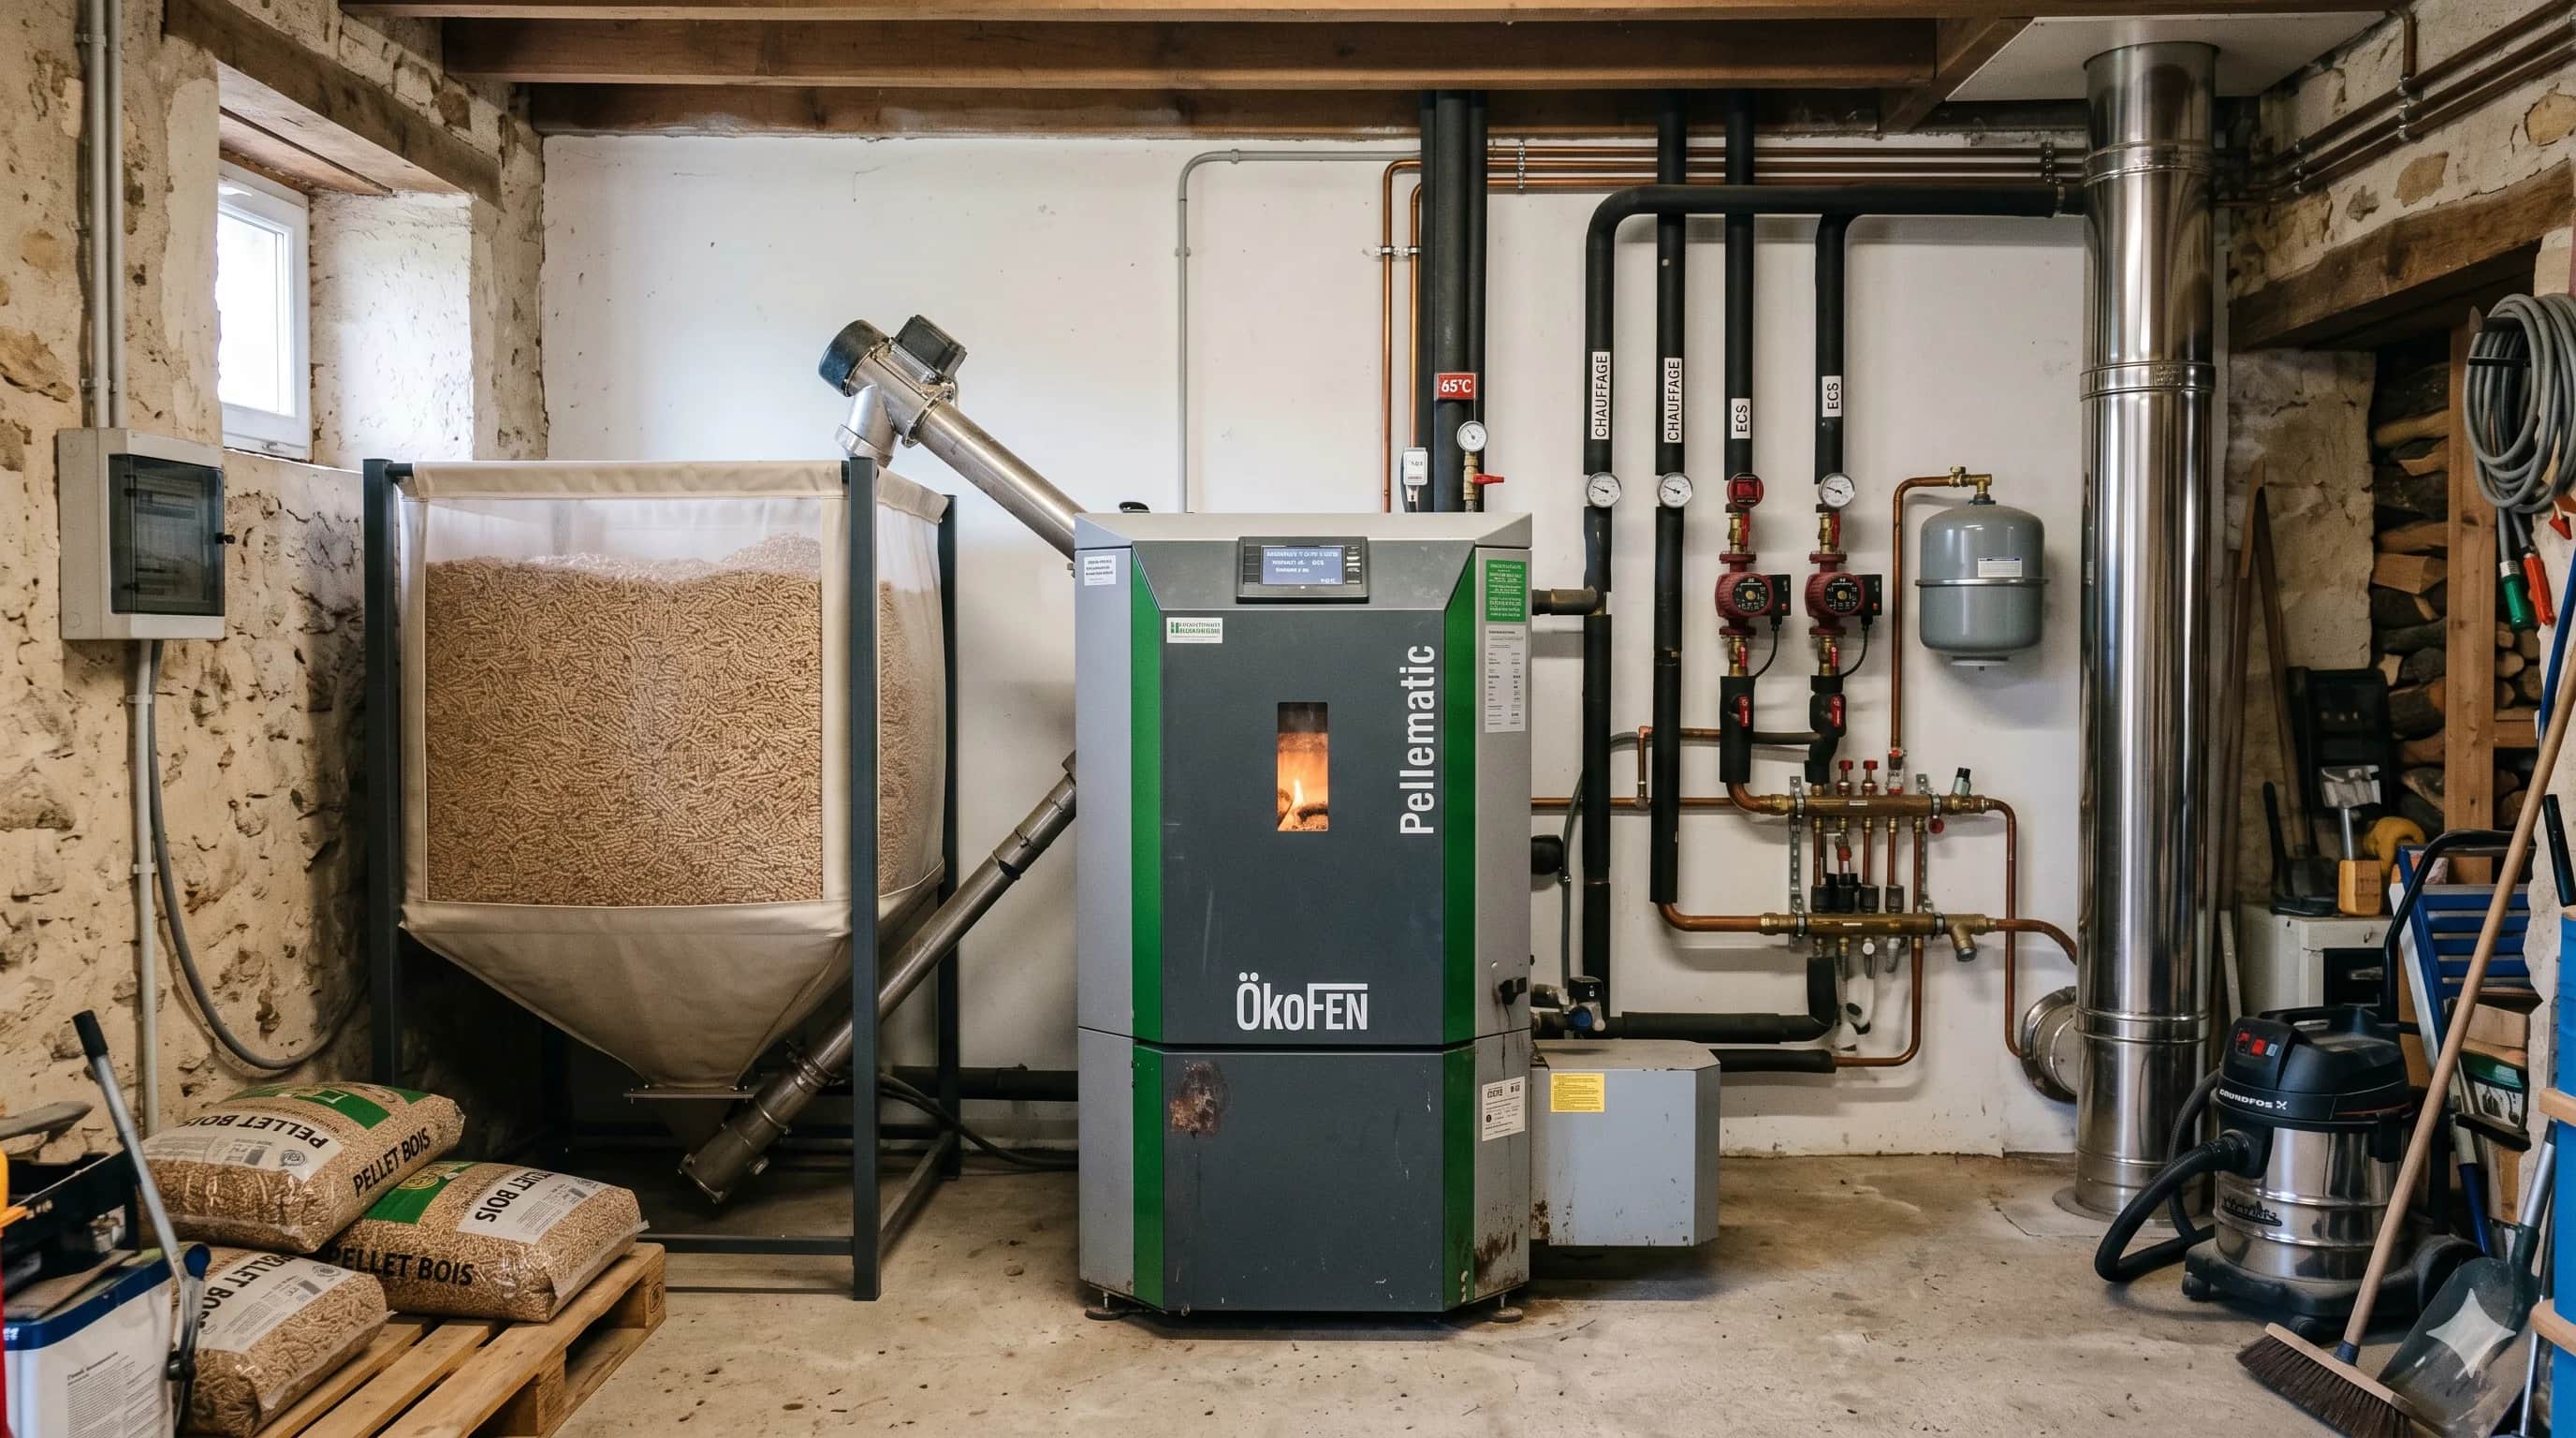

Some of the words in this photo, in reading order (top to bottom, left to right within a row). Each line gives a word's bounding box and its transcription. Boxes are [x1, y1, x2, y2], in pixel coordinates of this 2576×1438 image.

[1595, 355, 1608, 438] CHAUFFAGE
[1667, 360, 1680, 441] CHAUFFAGE
[1827, 382, 1839, 410] ECS
[1735, 404, 1748, 433] ECS
[1399, 645, 1435, 834] Pellematic
[237, 1116, 329, 1150] PELLET
[352, 1147, 399, 1198] PELLET
[401, 1127, 432, 1164] BOIS
[475, 1189, 520, 1223] BOIS
[417, 1256, 476, 1286] BOIS
[198, 1285, 235, 1329] BO
